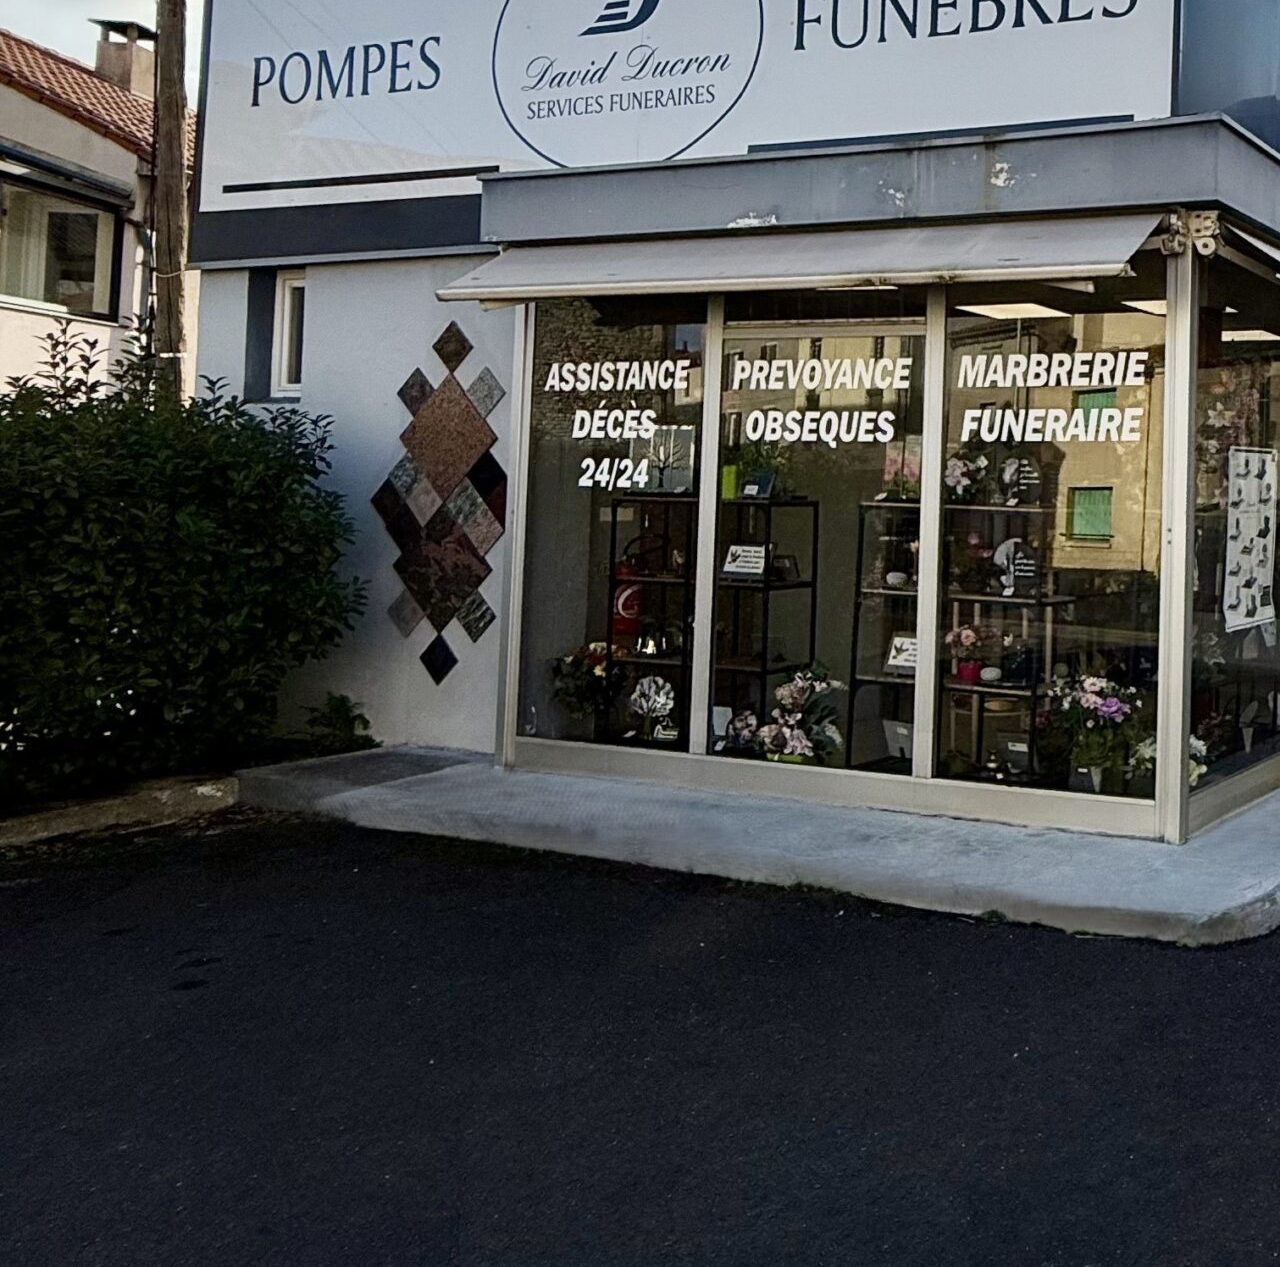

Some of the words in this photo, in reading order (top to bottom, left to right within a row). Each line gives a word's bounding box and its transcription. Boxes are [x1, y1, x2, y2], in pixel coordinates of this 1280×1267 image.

[251, 36, 442, 107] POMPES
[521, 51, 618, 92] David
[621, 44, 732, 82] Ducron
[527, 95, 604, 120] SERVICES
[610, 84, 716, 112] FUNERAIRES
[544, 359, 691, 392] ASSISTANCE
[732, 357, 913, 391] PREVOYANCE
[957, 352, 1149, 388] MARBRERIE
[572, 400, 657, 440] DÉCÈS
[745, 410, 896, 449] OBSEQUES
[960, 407, 1144, 443] FUNERAIRE
[578, 457, 649, 491] 24/24
